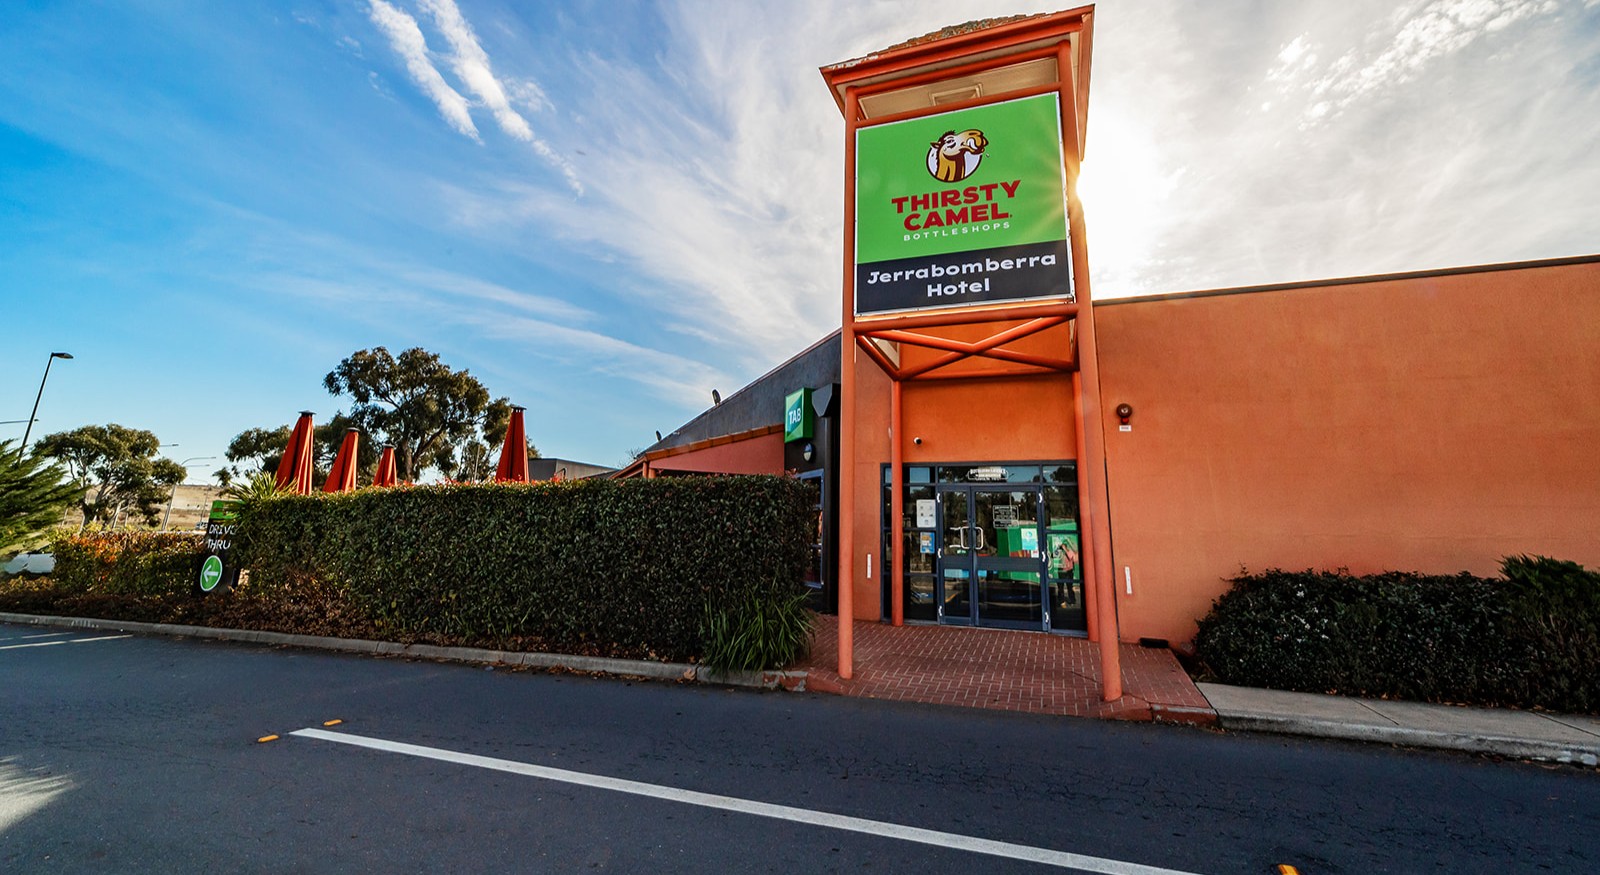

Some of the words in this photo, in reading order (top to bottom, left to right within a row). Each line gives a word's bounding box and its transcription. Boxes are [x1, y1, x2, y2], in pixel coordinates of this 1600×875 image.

[892, 180, 1021, 214] THIRSTY
[903, 203, 1010, 231] CAMEL
[903, 222, 1010, 241] BOTTLESHOPS
[867, 254, 1056, 284] Jerrabomberra
[927, 278, 990, 297] Hotel
[788, 407, 802, 424] TAB
[207, 538, 231, 550] THRU
